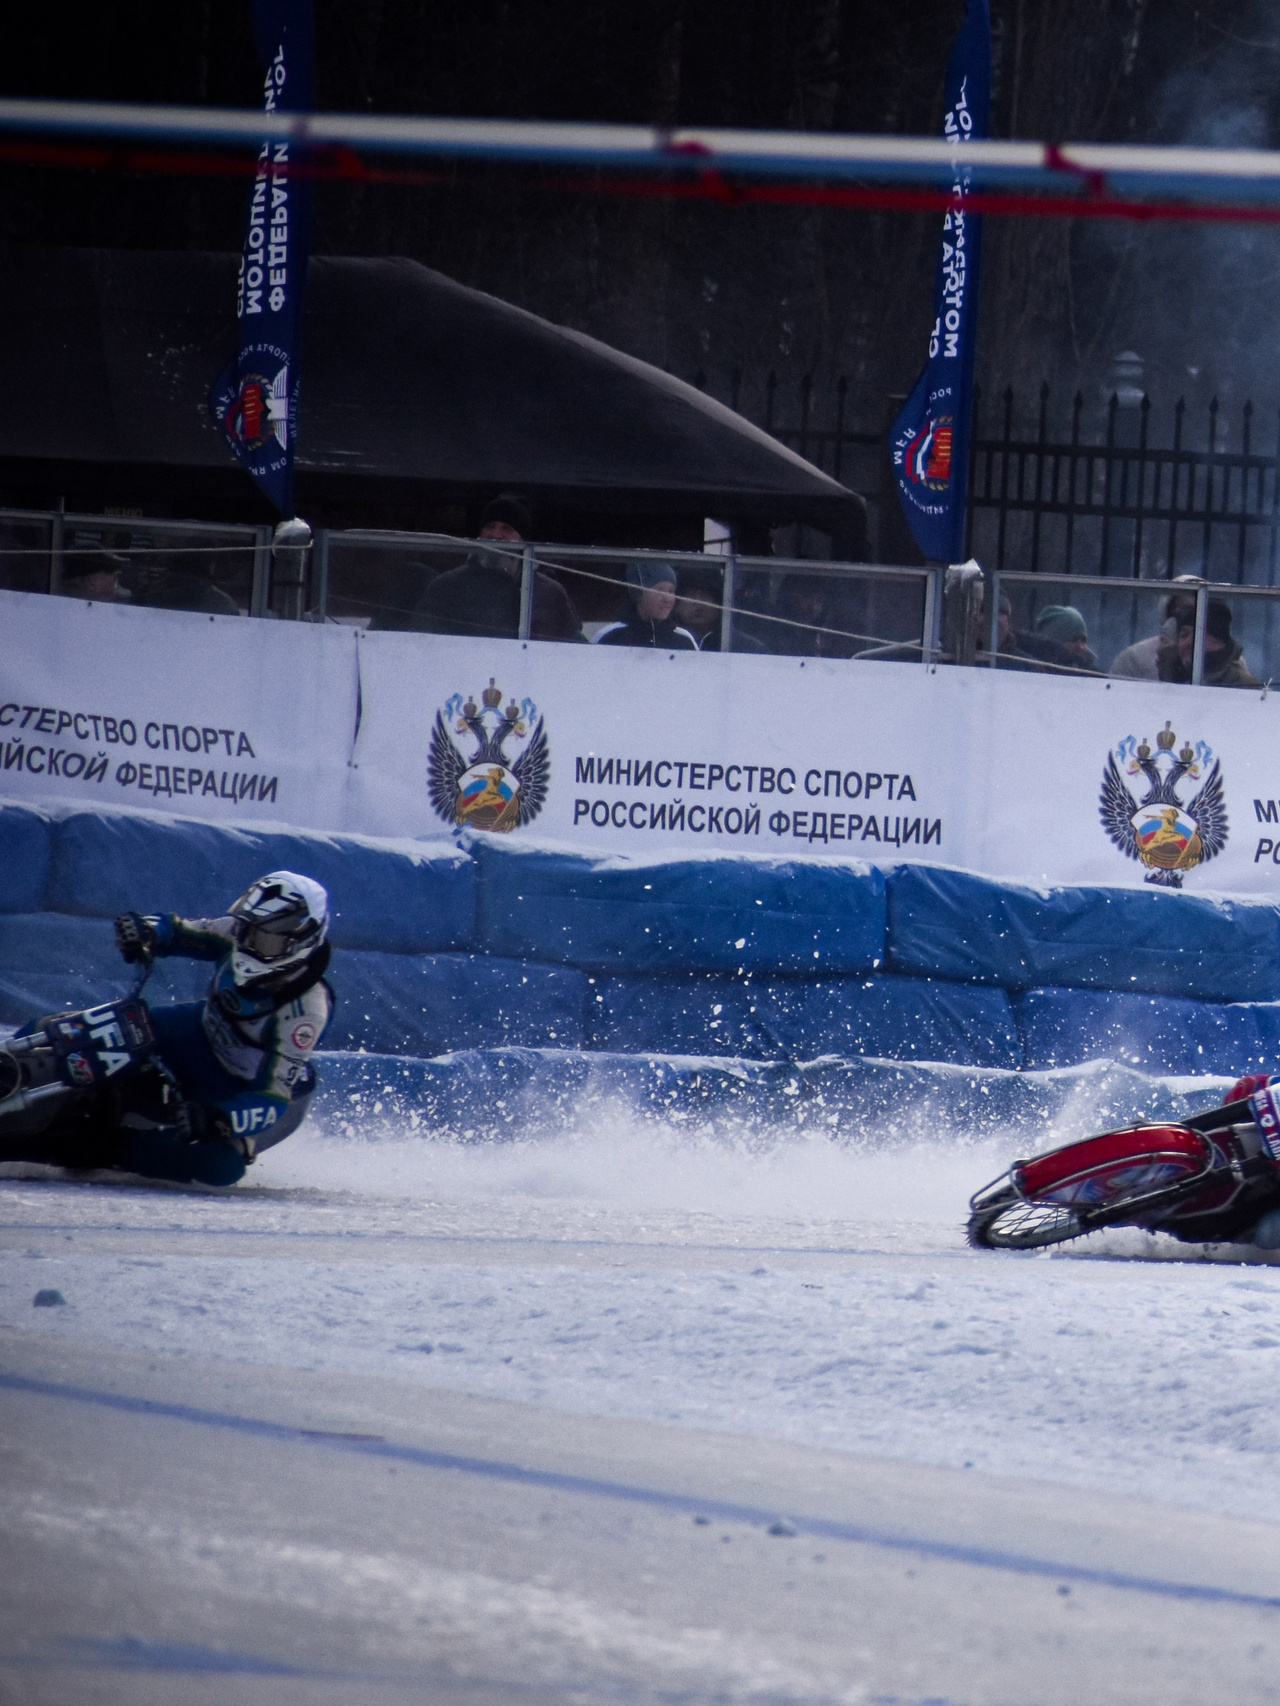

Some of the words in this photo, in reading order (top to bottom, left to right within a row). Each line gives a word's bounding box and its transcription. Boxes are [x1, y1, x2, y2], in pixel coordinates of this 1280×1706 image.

[0, 703, 137, 746] СТЕРСТВО
[144, 722, 256, 758] СПОРТА
[0, 737, 108, 783] ЙСКОЙ
[116, 760, 278, 804] ФЕДЕРАЦИИ
[575, 756, 796, 795] МИНИСТЕРСТВО
[804, 769, 917, 801] СПОРТА
[573, 798, 760, 835] РОССИЙСКОЙ
[768, 810, 942, 848] ФЕДЕРАЦИИ
[82, 1010, 132, 1078] UFA
[230, 1105, 278, 1134] UFA
